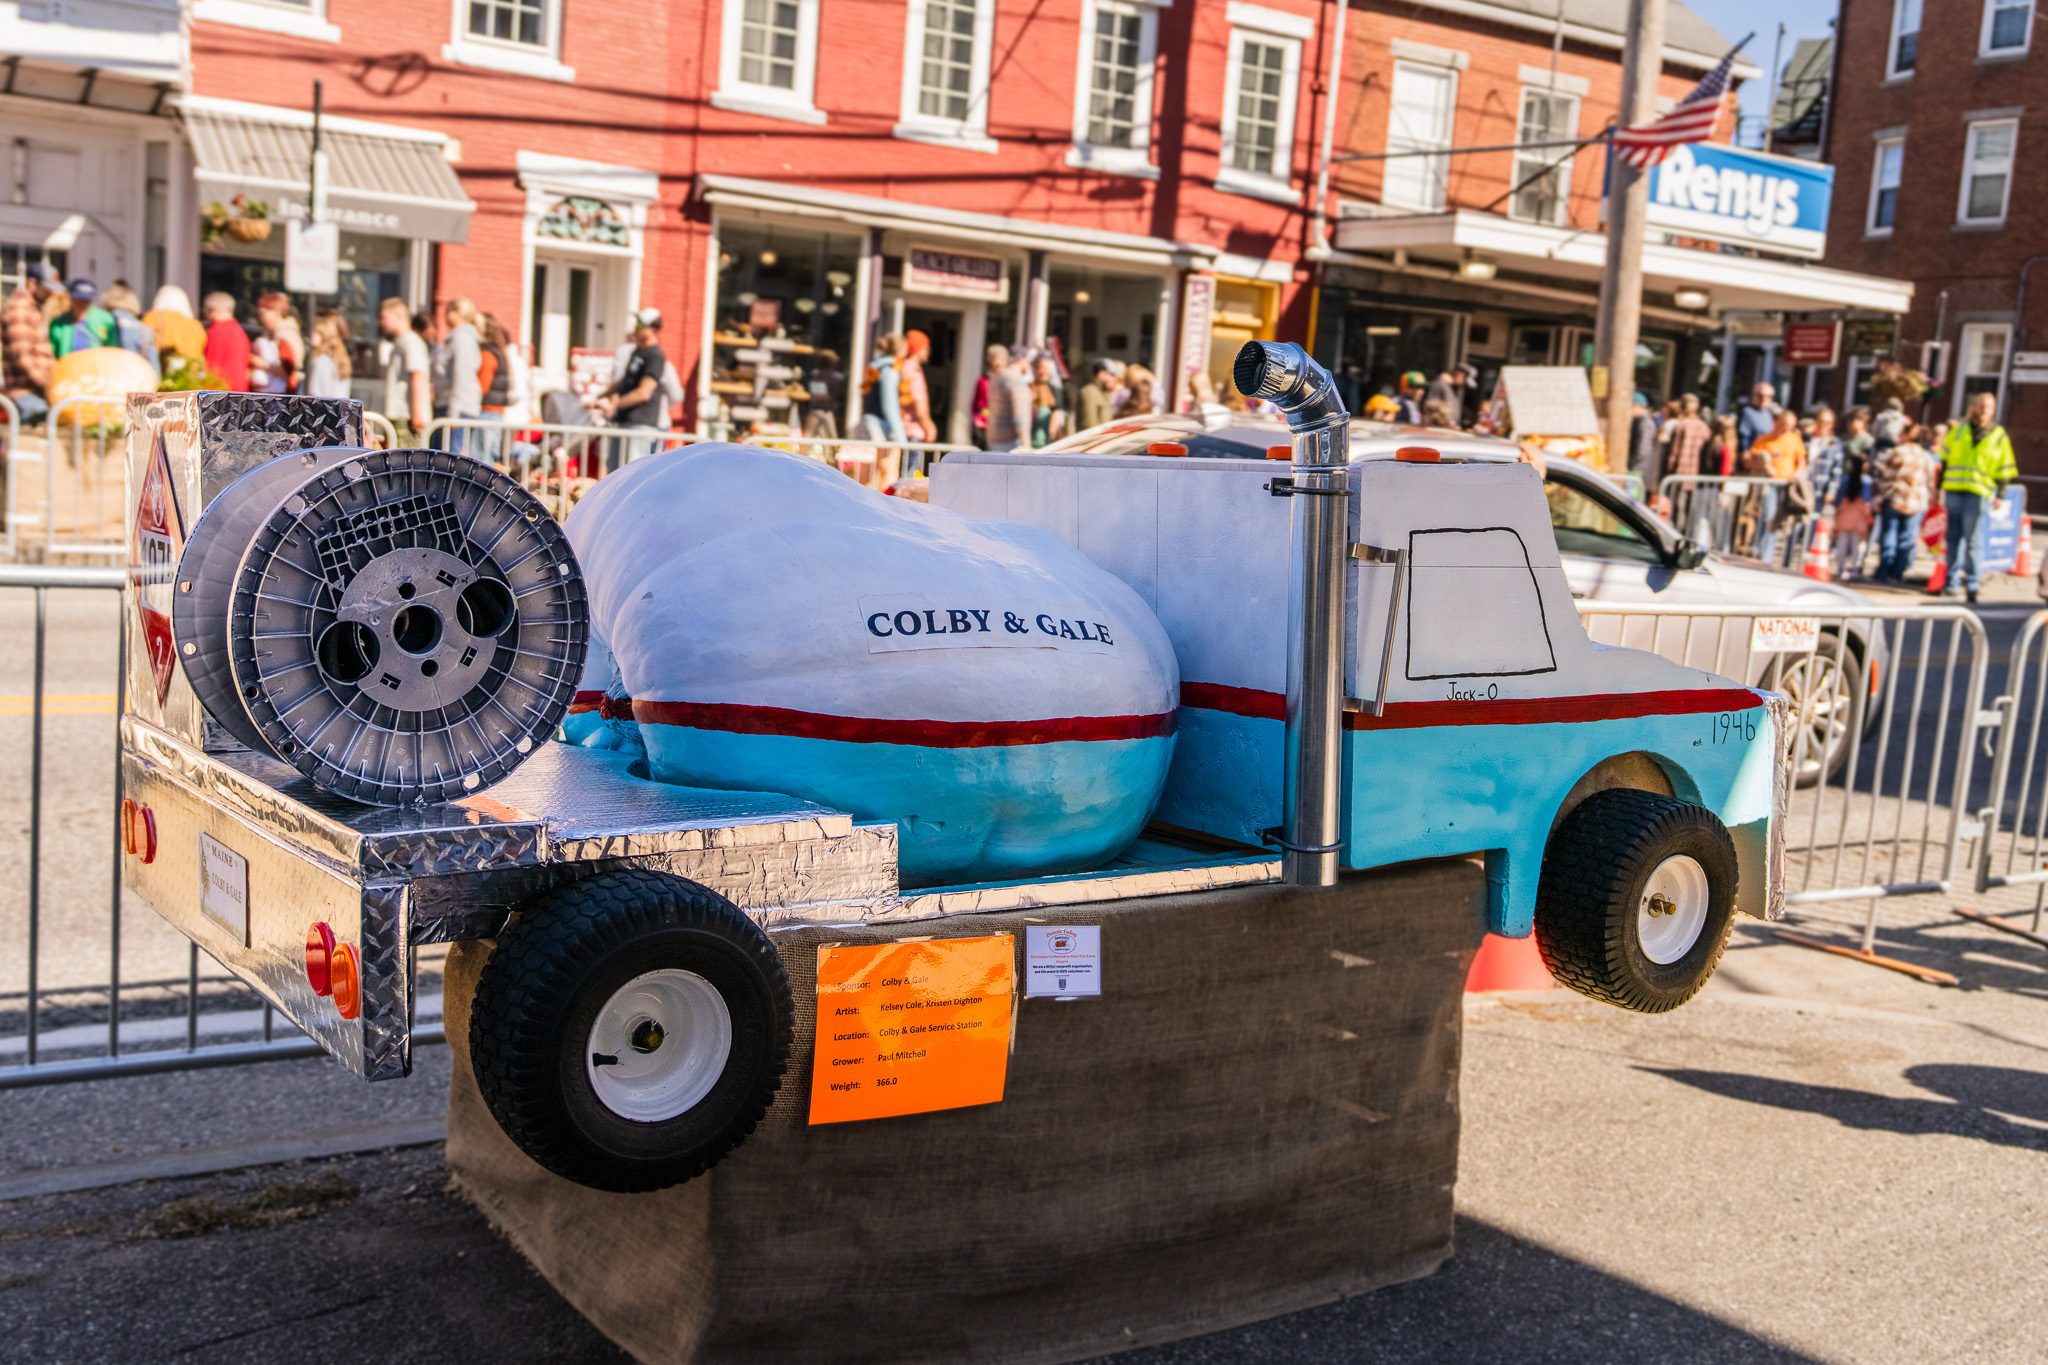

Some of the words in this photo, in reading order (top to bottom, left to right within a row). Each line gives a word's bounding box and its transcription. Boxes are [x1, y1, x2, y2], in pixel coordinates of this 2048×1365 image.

[1656, 143, 1800, 237] Renys
[867, 609, 991, 637] COLBY
[1003, 611, 1029, 634] &
[1036, 614, 1114, 646] GALE
[1759, 619, 1815, 636] NATIONAL
[156, 635, 163, 670] 2
[1446, 681, 1498, 701] Jack-O
[1712, 712, 1756, 745] 1946
[211, 844, 233, 868] MAINE
[837, 981, 870, 992] Sponsor:
[881, 978, 902, 987] Colby
[904, 977, 910, 985] &
[912, 976, 929, 984] Gale
[835, 1007, 860, 1016] Artist:
[880, 1003, 904, 1012] Kelsey
[906, 1001, 924, 1010] Cole,
[926, 999, 952, 1008] Kristen
[954, 997, 983, 1007] Dighton
[834, 1031, 870, 1041] Location:
[879, 1028, 900, 1037] Colby
[902, 1026, 908, 1035] &
[910, 1025, 927, 1034] Gale
[928, 1022, 955, 1032] Service
[956, 1020, 983, 1030] Station
[832, 1056, 864, 1067] Grower:
[878, 1052, 894, 1062] Paul
[895, 1050, 926, 1060] Mitchell
[830, 1081, 861, 1092] Weight:
[876, 1077, 898, 1087] 366.0
